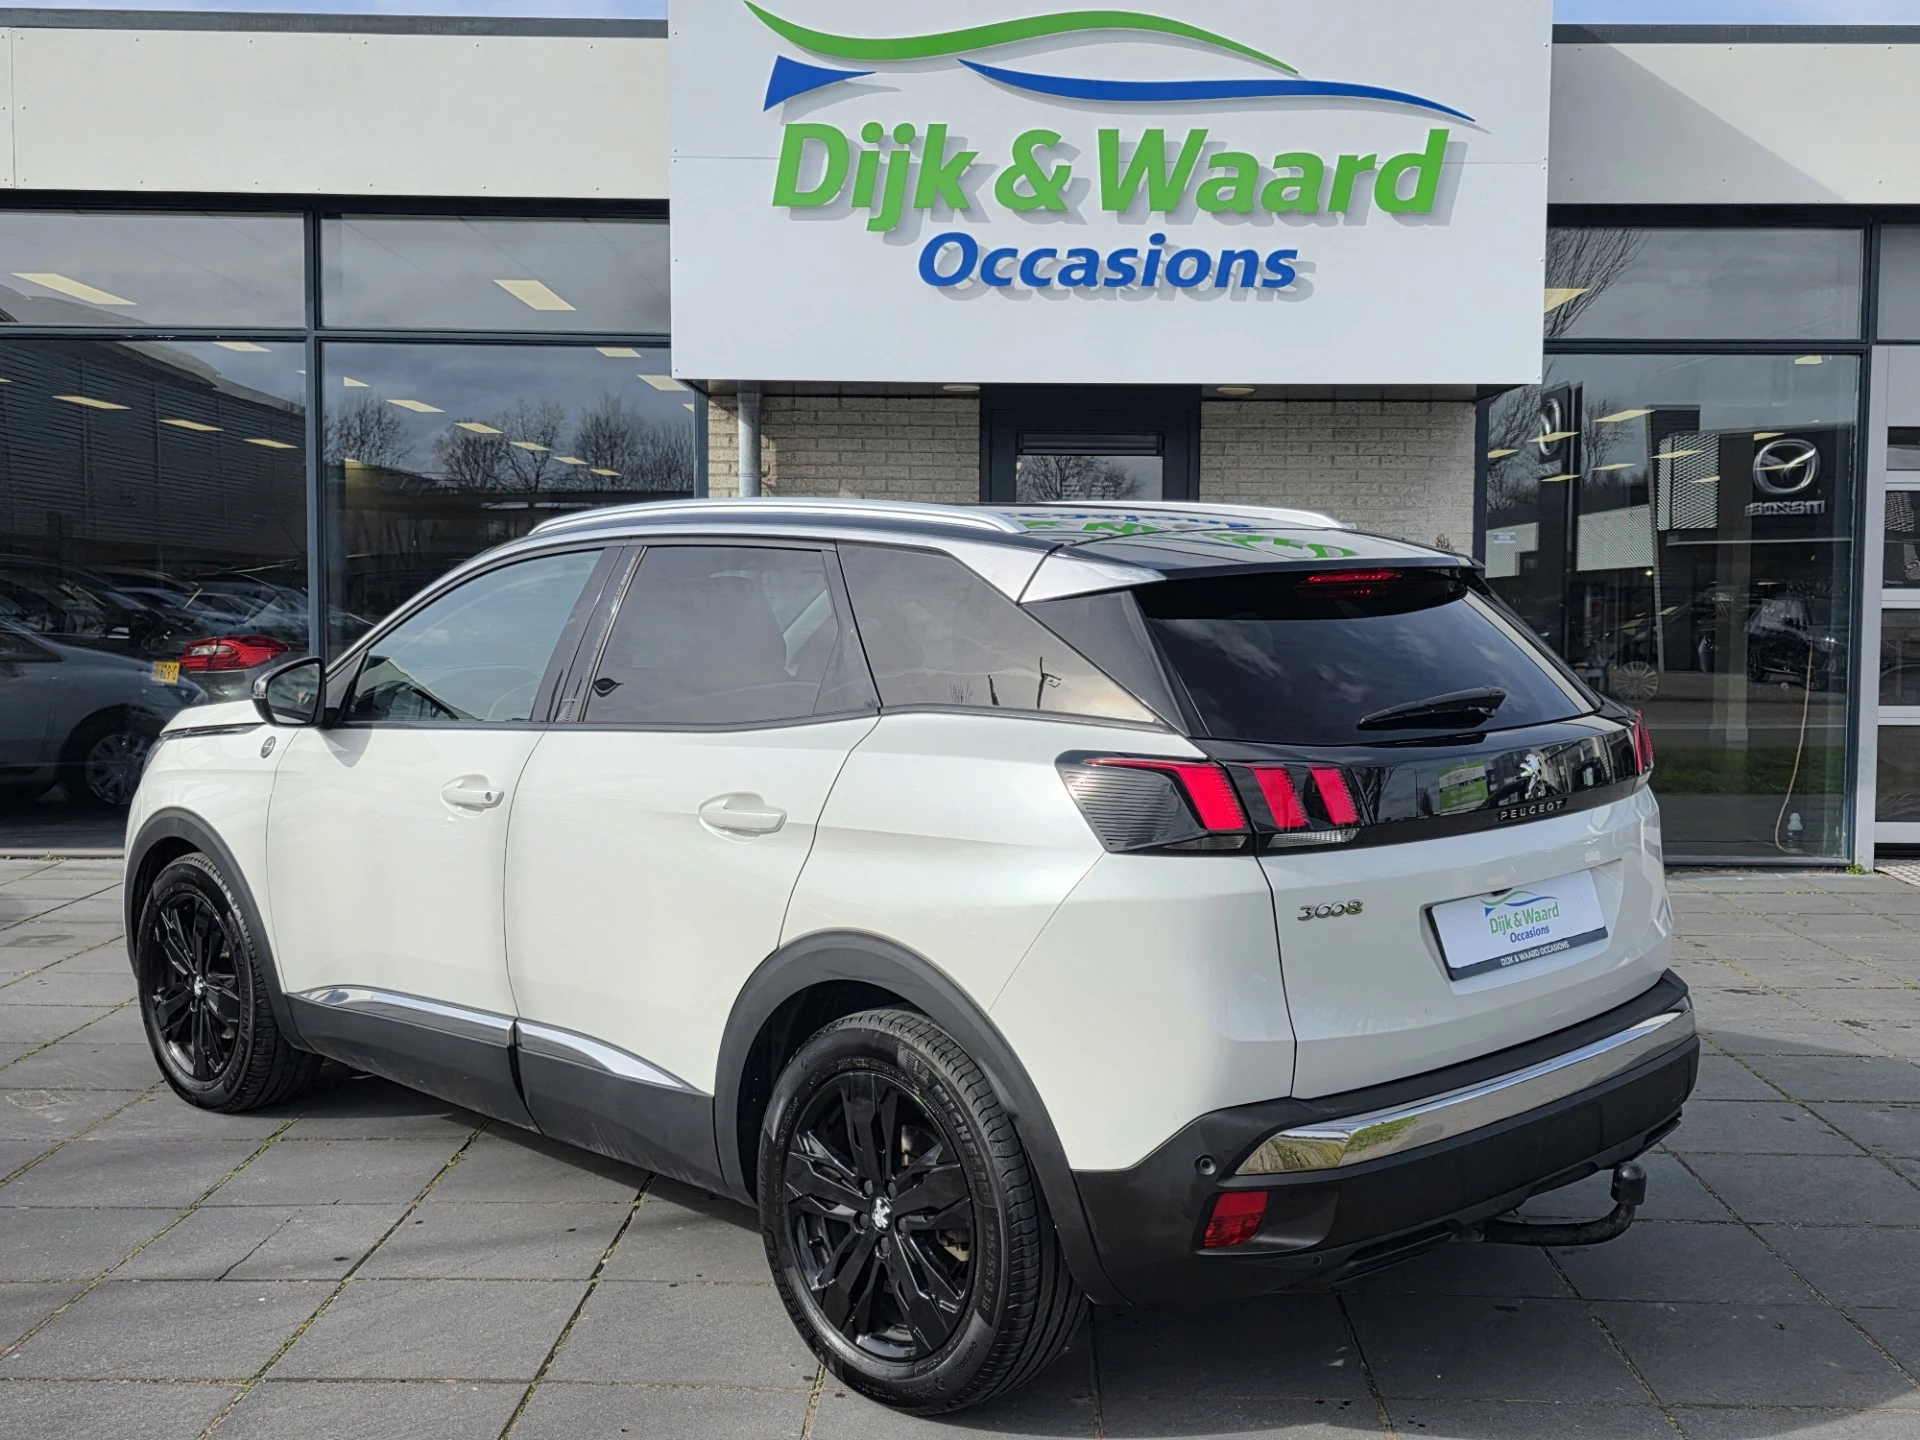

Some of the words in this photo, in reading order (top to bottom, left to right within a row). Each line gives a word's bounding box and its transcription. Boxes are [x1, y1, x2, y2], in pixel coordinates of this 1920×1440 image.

[773, 122, 977, 232] Dijk
[995, 129, 1072, 213] &
[1097, 128, 1449, 214] Waard
[918, 231, 1298, 289] Occasions
[1500, 800, 1563, 820] PEUGEOT
[1297, 899, 1364, 921] 3008
[1490, 916, 1512, 935] Dijk
[1513, 911, 1524, 927] &
[1523, 901, 1560, 924] Waard
[1510, 925, 1550, 943] Occasions
[1519, 948, 1540, 961] WAARD
[1540, 940, 1570, 955] OCCASIONS
